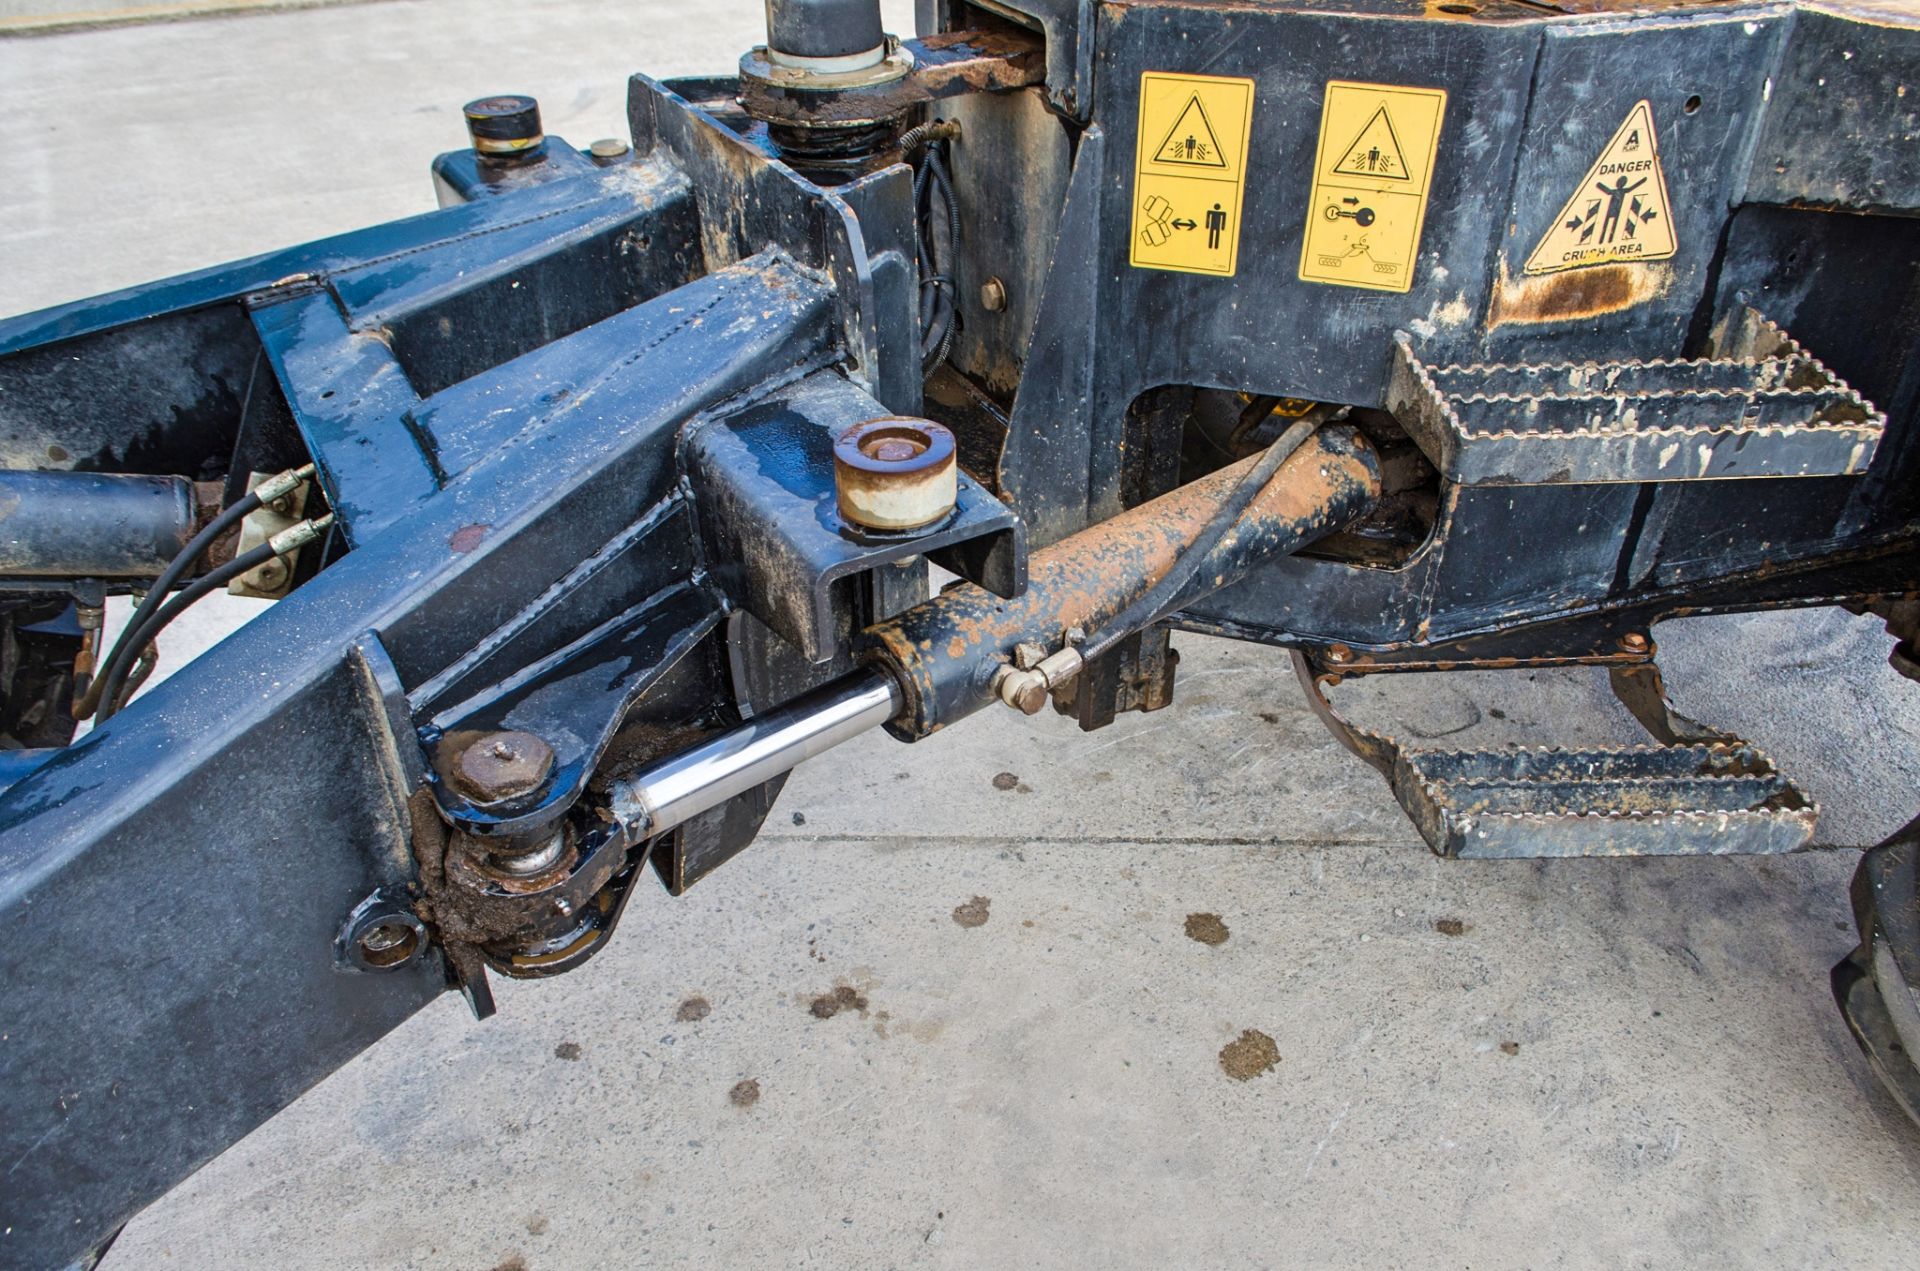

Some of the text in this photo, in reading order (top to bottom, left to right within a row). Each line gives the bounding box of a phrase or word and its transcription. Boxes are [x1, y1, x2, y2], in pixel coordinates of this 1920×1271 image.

[1626, 130, 1639, 145] A
[1600, 160, 1652, 175] DANGER
[1610, 243, 1643, 255] AREA
